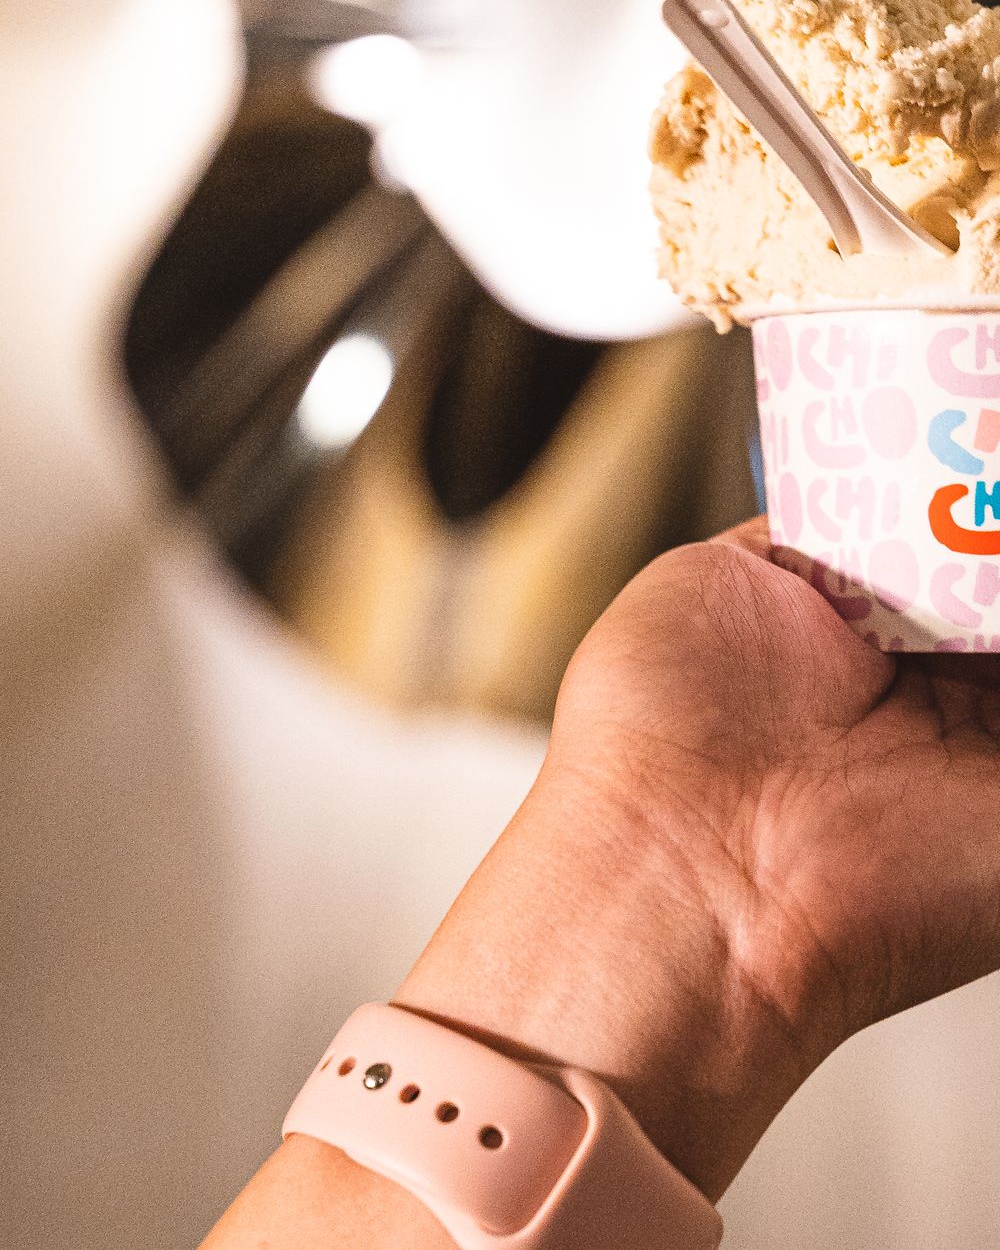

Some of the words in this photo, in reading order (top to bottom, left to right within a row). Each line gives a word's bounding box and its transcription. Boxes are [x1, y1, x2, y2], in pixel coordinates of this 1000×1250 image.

[797, 324, 897, 391] CHI
[802, 386, 918, 470] CHO
[807, 476, 901, 542] CHI
